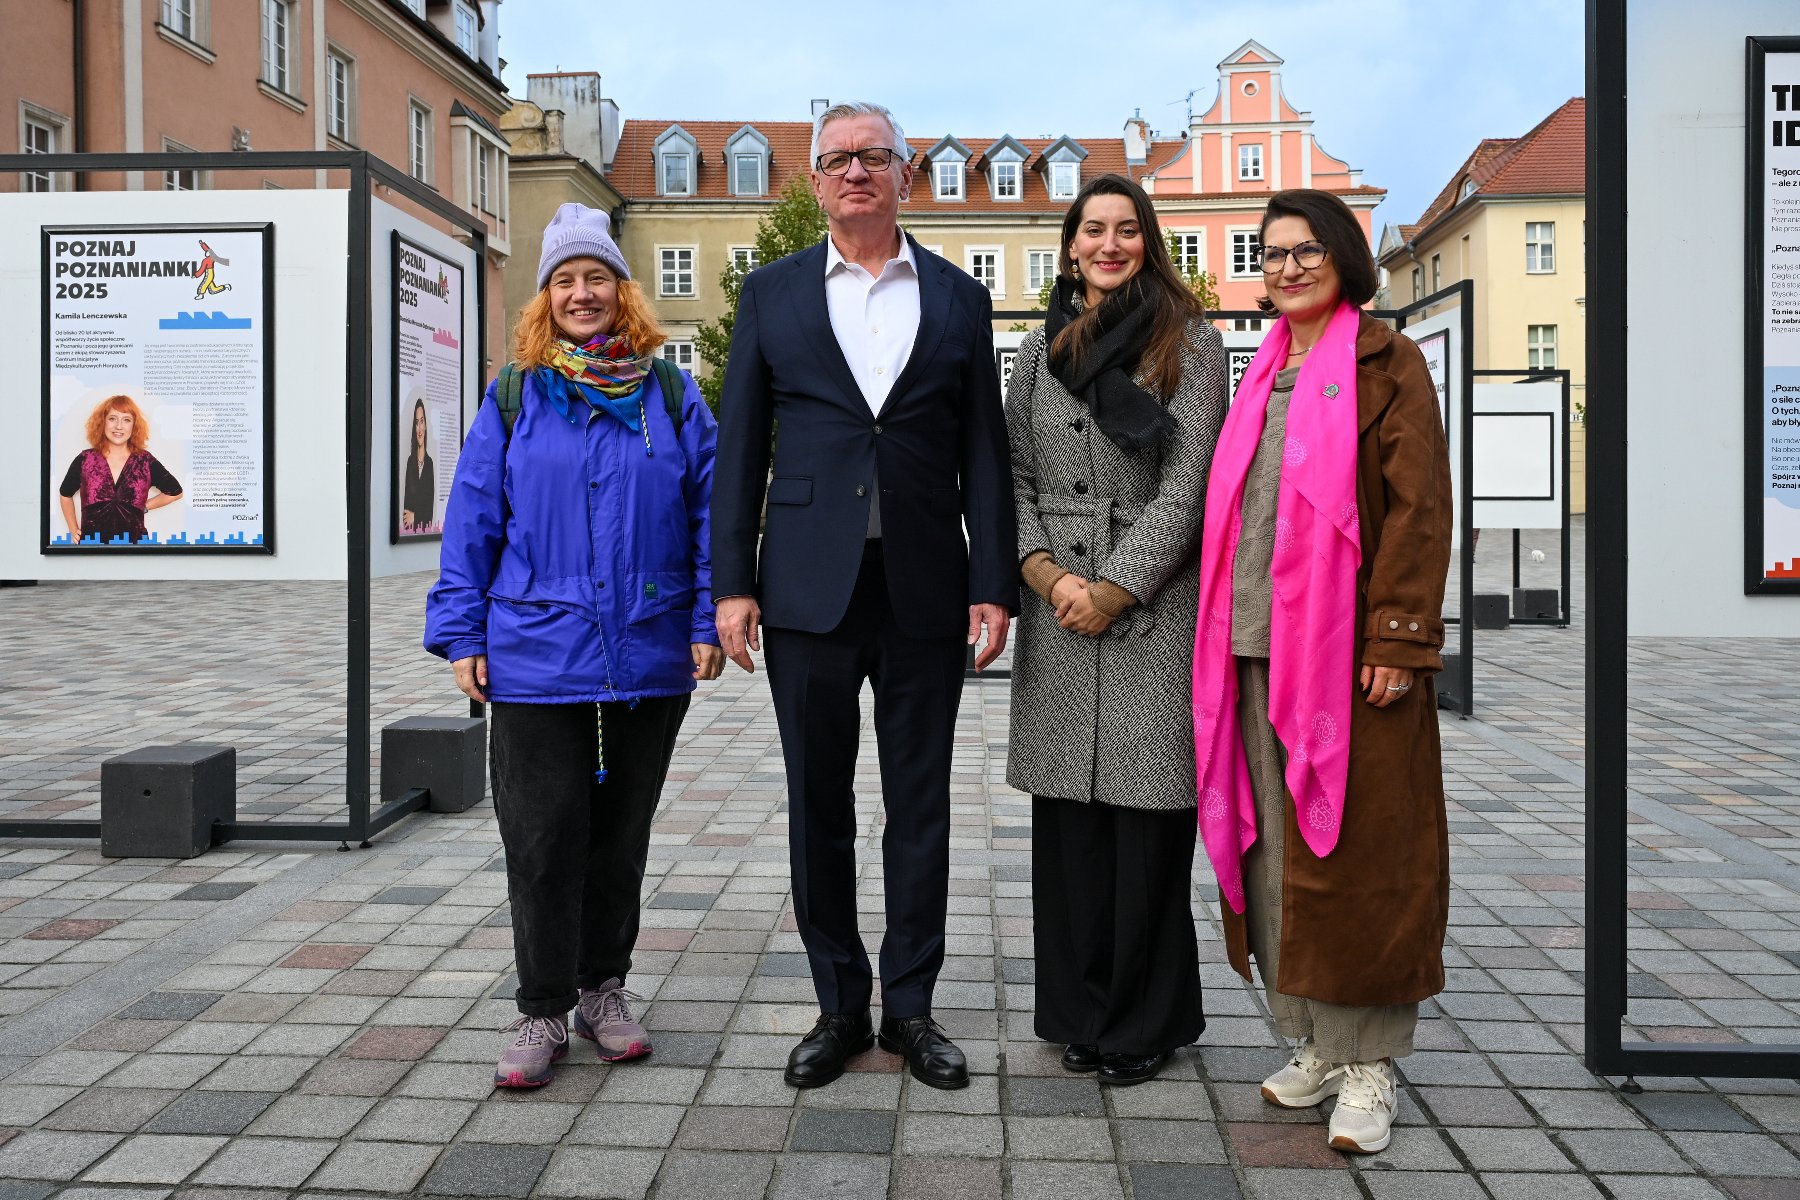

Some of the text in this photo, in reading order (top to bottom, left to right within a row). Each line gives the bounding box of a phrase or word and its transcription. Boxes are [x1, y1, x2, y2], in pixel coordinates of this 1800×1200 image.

[1778, 179, 1791, 187] ale
[1771, 208, 1786, 216] Tym
[56, 240, 136, 257] POZNAJ
[400, 247, 426, 273] POZNAJ
[56, 260, 197, 278] POZNANIANKI
[56, 283, 108, 300] 2025
[400, 287, 418, 308] 2025
[55, 312, 128, 320] Kamila Lenczewska
[1778, 395, 1794, 404] sile
[1771, 406, 1779, 415] O
[1771, 418, 1788, 428] aby
[1772, 473, 1796, 481] Spójrz
[1772, 482, 1797, 490] Poznaj
